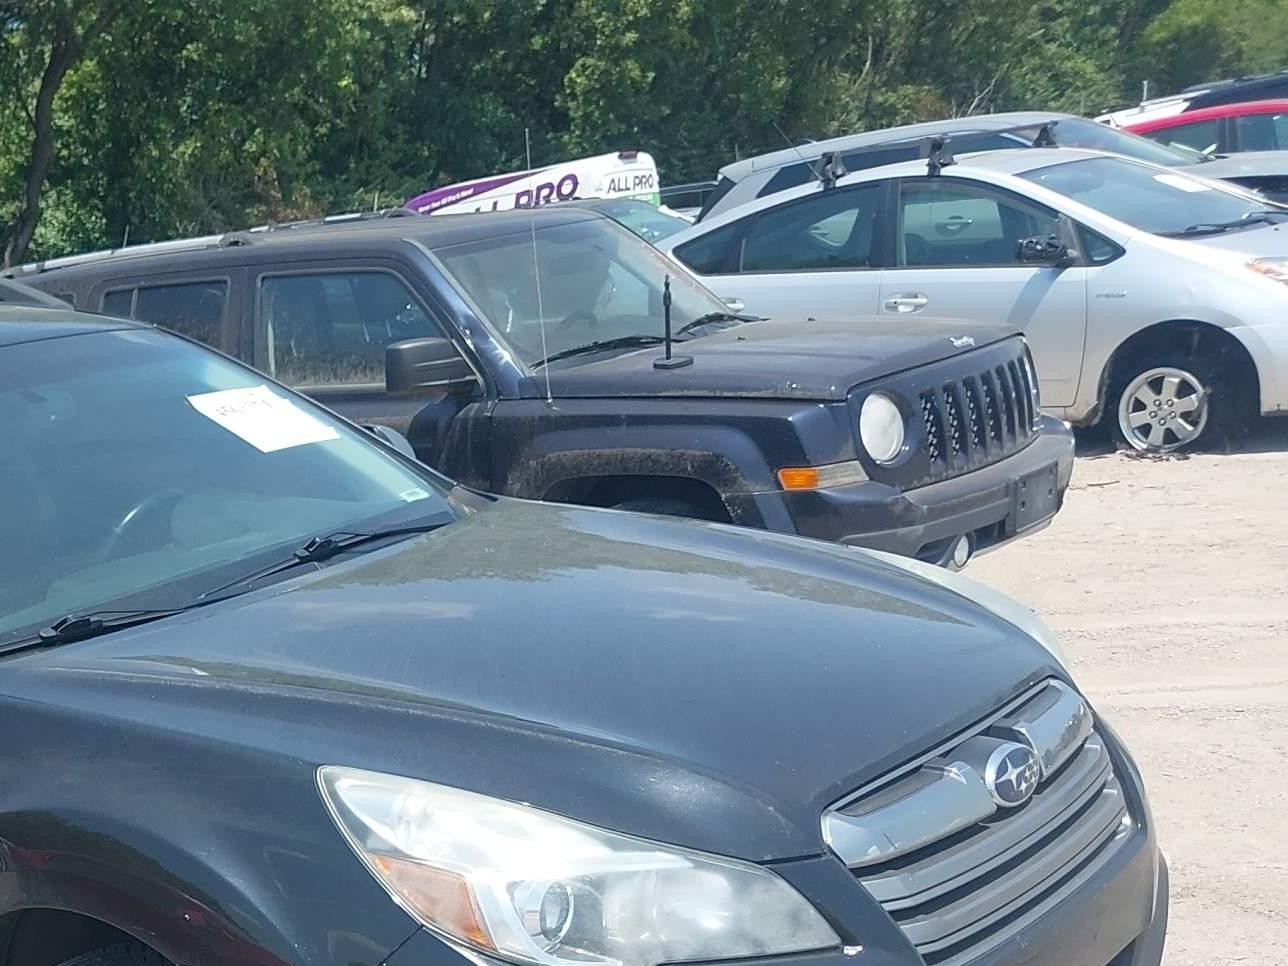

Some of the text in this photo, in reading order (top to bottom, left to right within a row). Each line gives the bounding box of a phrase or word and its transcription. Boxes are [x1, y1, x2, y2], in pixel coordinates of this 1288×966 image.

[514, 173, 580, 209] PRO
[607, 173, 654, 193] ALL PRO
